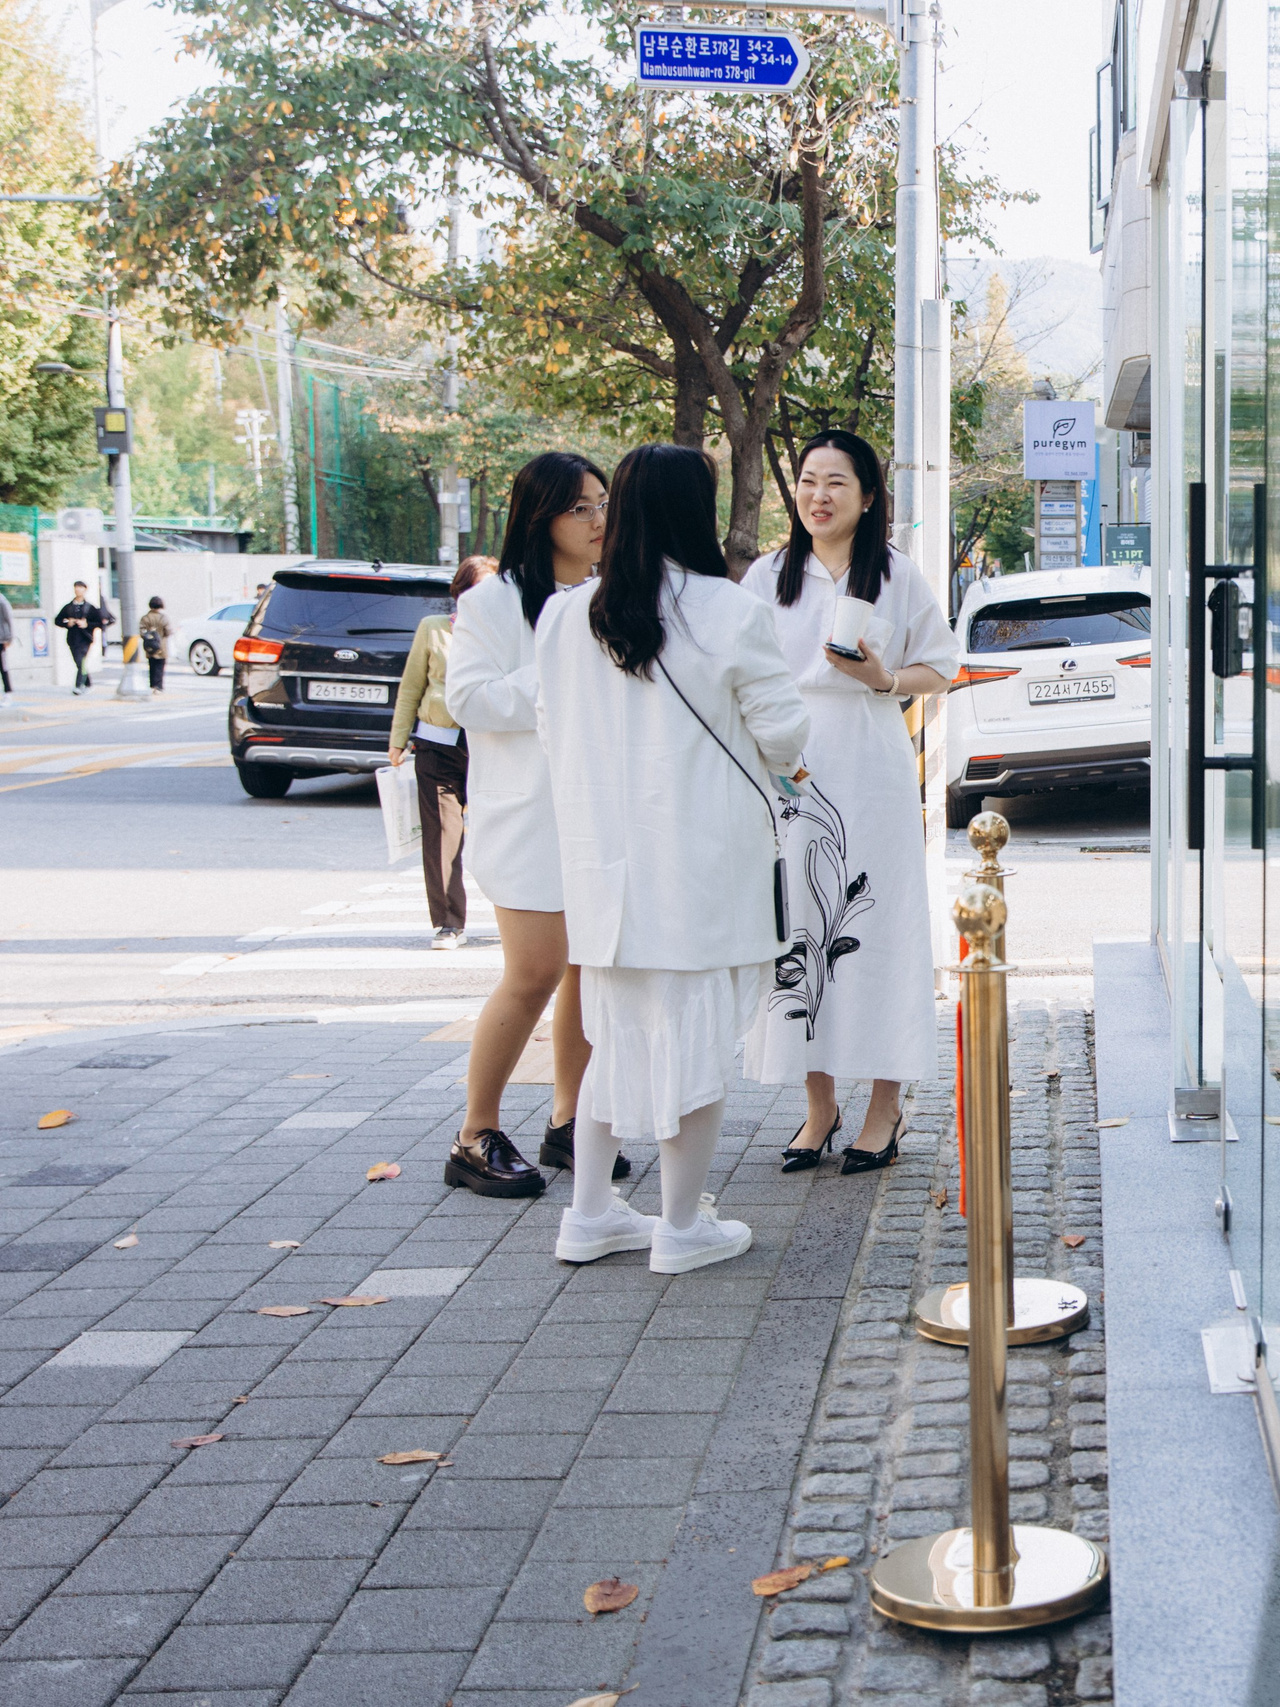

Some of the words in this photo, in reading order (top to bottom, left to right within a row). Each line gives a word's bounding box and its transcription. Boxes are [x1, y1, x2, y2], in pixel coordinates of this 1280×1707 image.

[643, 35, 740, 62] 남부순환로378길
[747, 40, 773, 53] 34-2
[761, 54, 792, 66] 34-14
[643, 62, 723, 79] Nambusunhwan-ro
[725, 66, 755, 82] 378-gil
[1033, 440, 1086, 450] puregym
